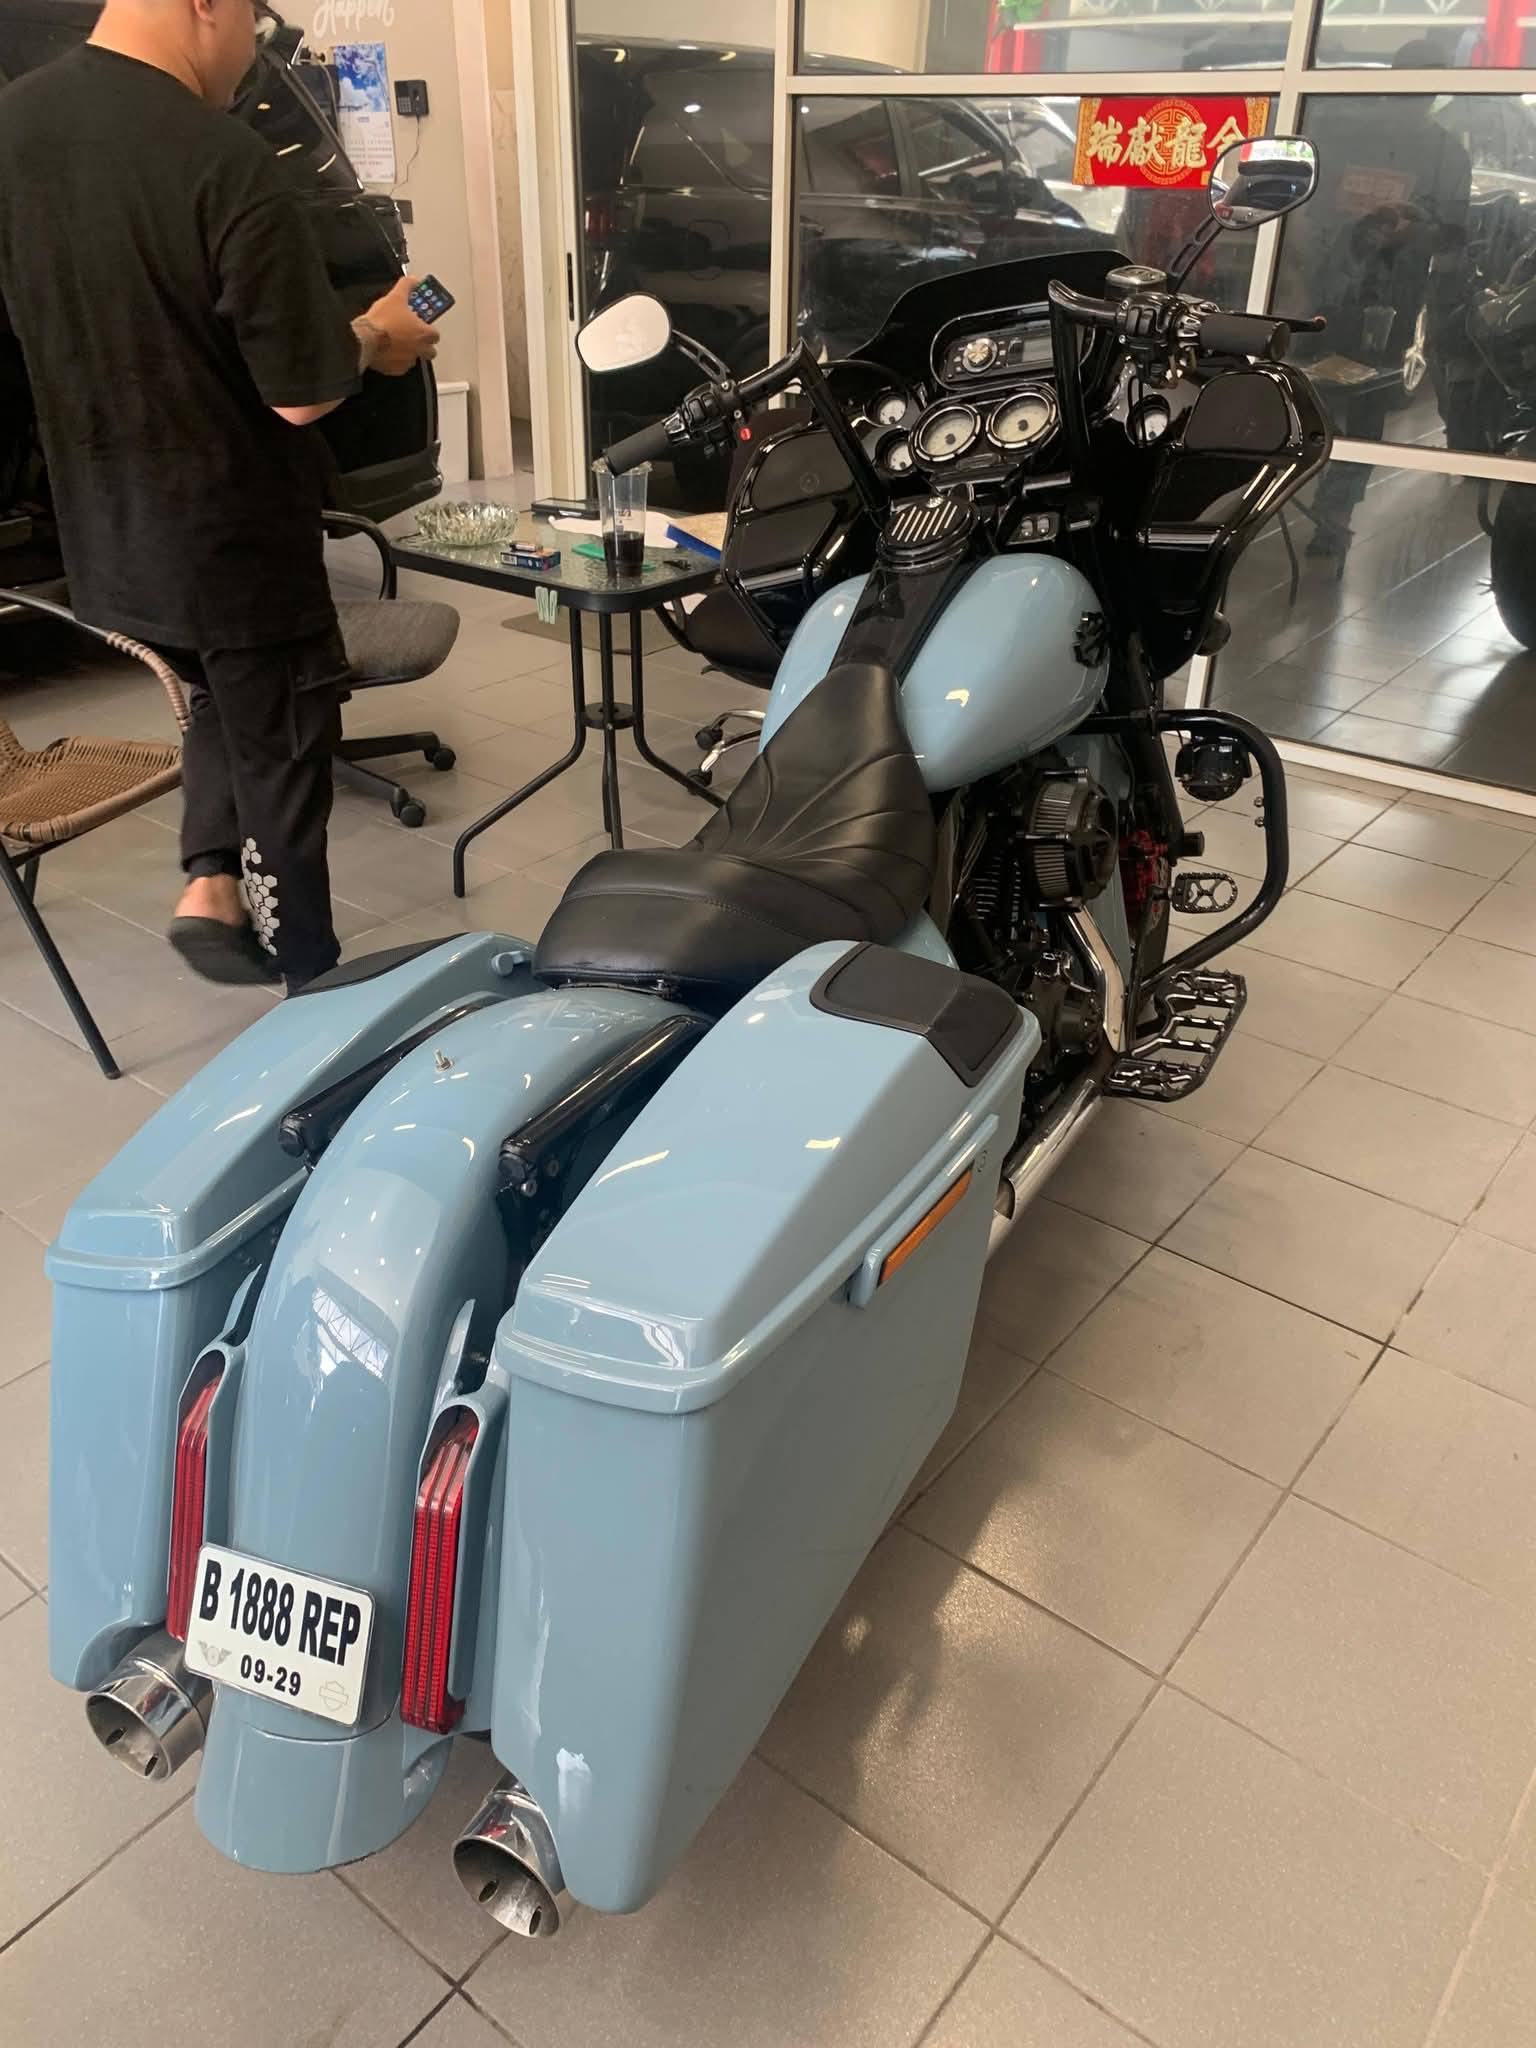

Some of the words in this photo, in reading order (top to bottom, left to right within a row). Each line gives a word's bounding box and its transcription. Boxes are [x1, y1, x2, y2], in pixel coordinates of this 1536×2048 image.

[200, 1559, 222, 1621] B
[230, 1568, 294, 1646] 1888
[299, 1590, 361, 1666] REP
[240, 1654, 301, 1696] 09-29
